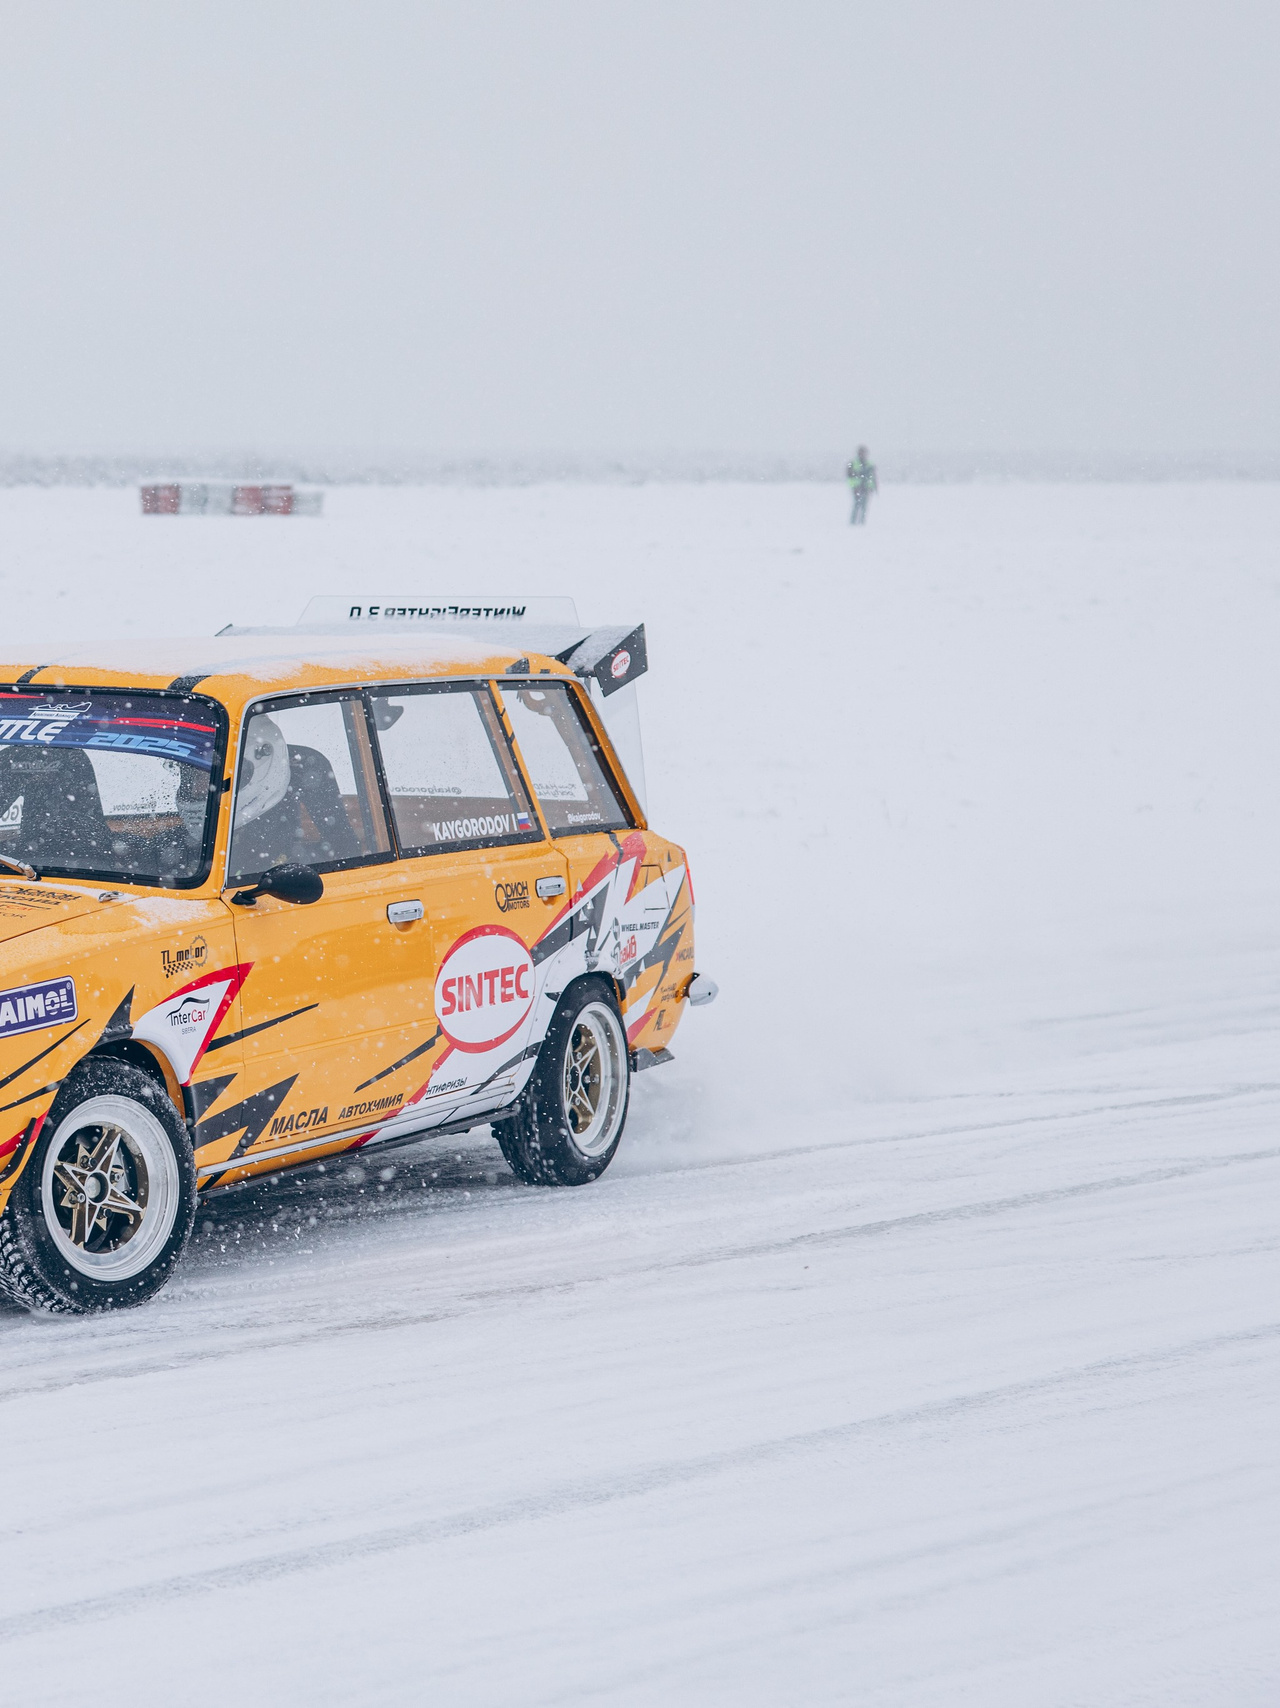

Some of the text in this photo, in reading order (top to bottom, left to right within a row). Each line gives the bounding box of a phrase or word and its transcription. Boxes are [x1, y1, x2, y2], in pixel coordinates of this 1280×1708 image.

[85, 731, 197, 757] 2025
[432, 815, 510, 842] KAYGORODOV
[507, 900, 530, 911] MOTORS
[441, 963, 529, 1016] SINTEC
[169, 1009, 206, 1026] InterCar
[269, 1106, 328, 1136] МАСЛА
[338, 1093, 404, 1120] АВТОХИМИЯ
